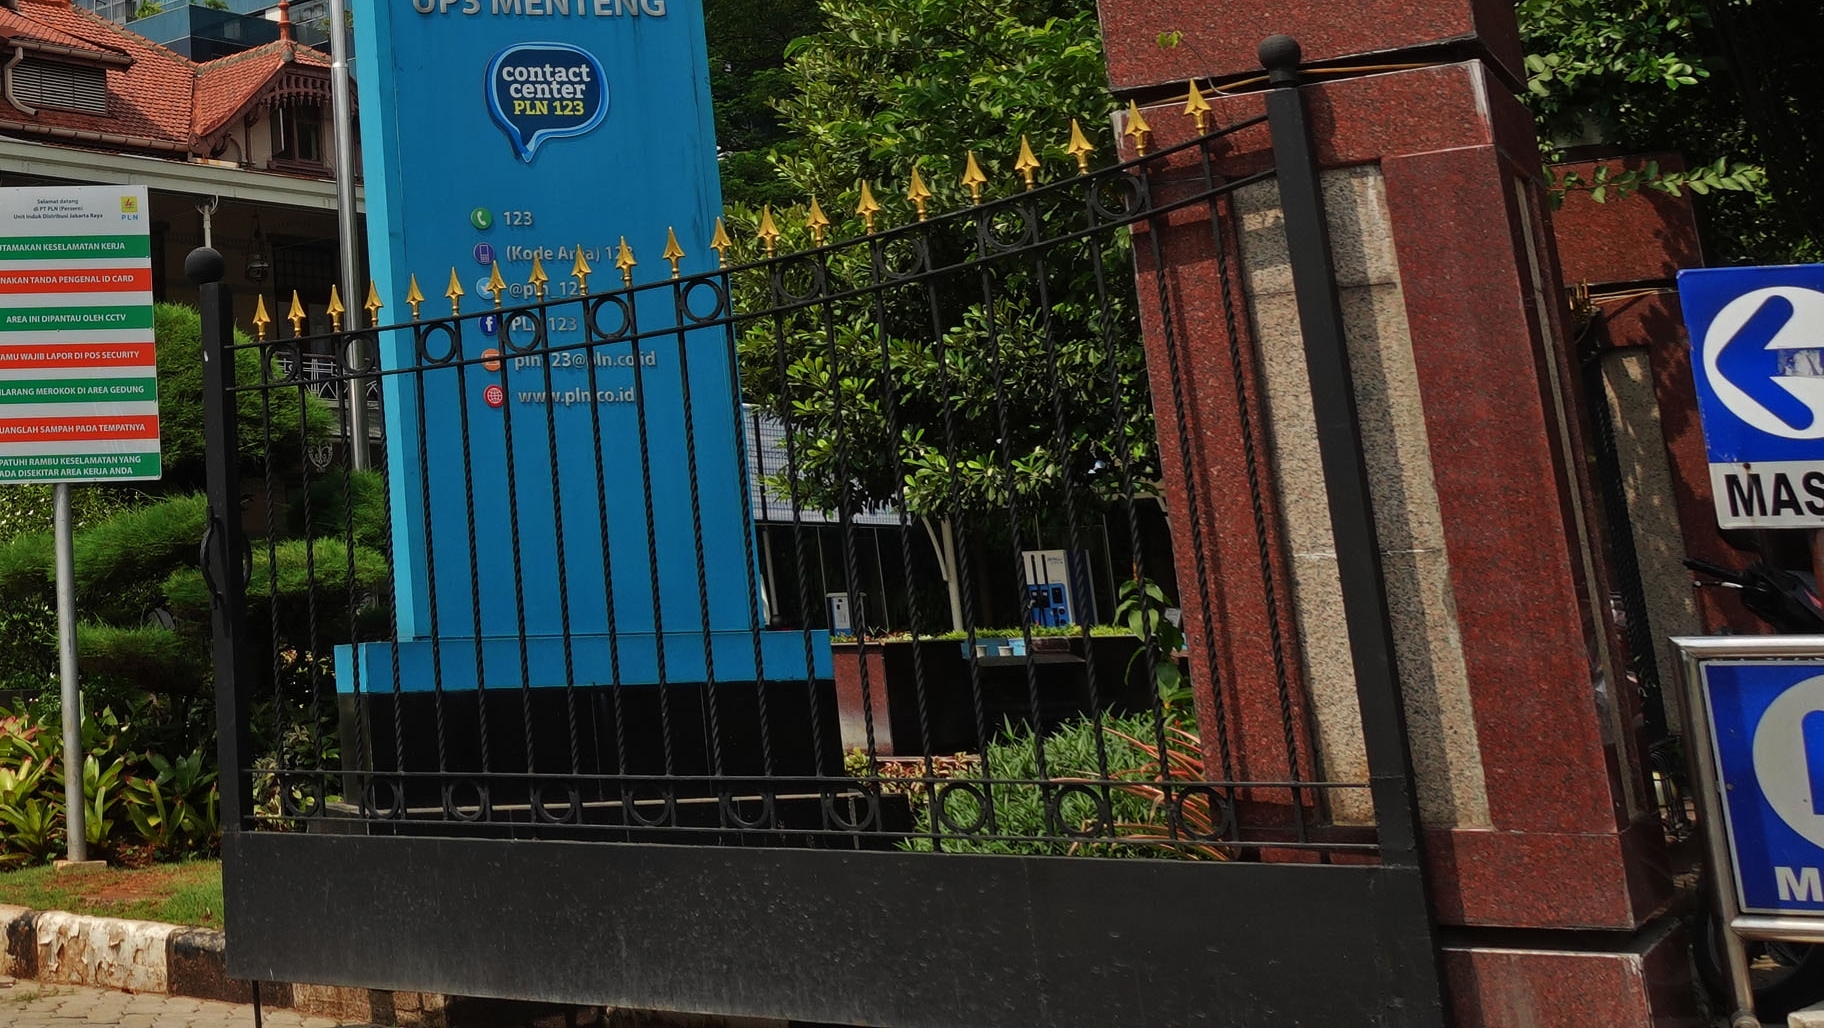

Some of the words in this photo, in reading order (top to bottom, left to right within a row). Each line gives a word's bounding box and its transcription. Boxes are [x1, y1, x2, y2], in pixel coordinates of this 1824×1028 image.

[502, 63, 591, 82] contact
[509, 80, 586, 99] center
[512, 100, 549, 115] PLN
[552, 100, 585, 115] 123
[503, 211, 533, 226] 123
[43, 243, 100, 251] KESELAMATAN
[101, 242, 125, 250] KERJA
[506, 245, 554, 261] (Kode
[30, 276, 58, 284] TANDA
[59, 276, 101, 284] PENGENAL
[102, 275, 111, 283] ID
[112, 275, 134, 283] CARD
[29, 315, 40, 323] INI
[83, 314, 104, 322] OLEH
[548, 317, 577, 331] 123
[20, 352, 44, 361] WAJIB
[46, 352, 72, 360] LAPOR
[84, 351, 100, 359] POS
[101, 351, 139, 359] SECURITY
[36, 387, 76, 395] MEROKOK
[77, 387, 86, 395] DI
[87, 386, 109, 394] AREA
[110, 385, 144, 394] GEDUNG
[40, 425, 74, 433] SAMPAH
[75, 425, 97, 433] PADA
[98, 423, 145, 432] TEMPATNYA
[29, 458, 58, 466] RAMBU
[60, 457, 118, 465] KESELAMATAN
[0, 470, 17, 478] ADA
[18, 469, 59, 477] DISEKITAR
[60, 468, 82, 476] AREA
[109, 467, 133, 475] ANDA
